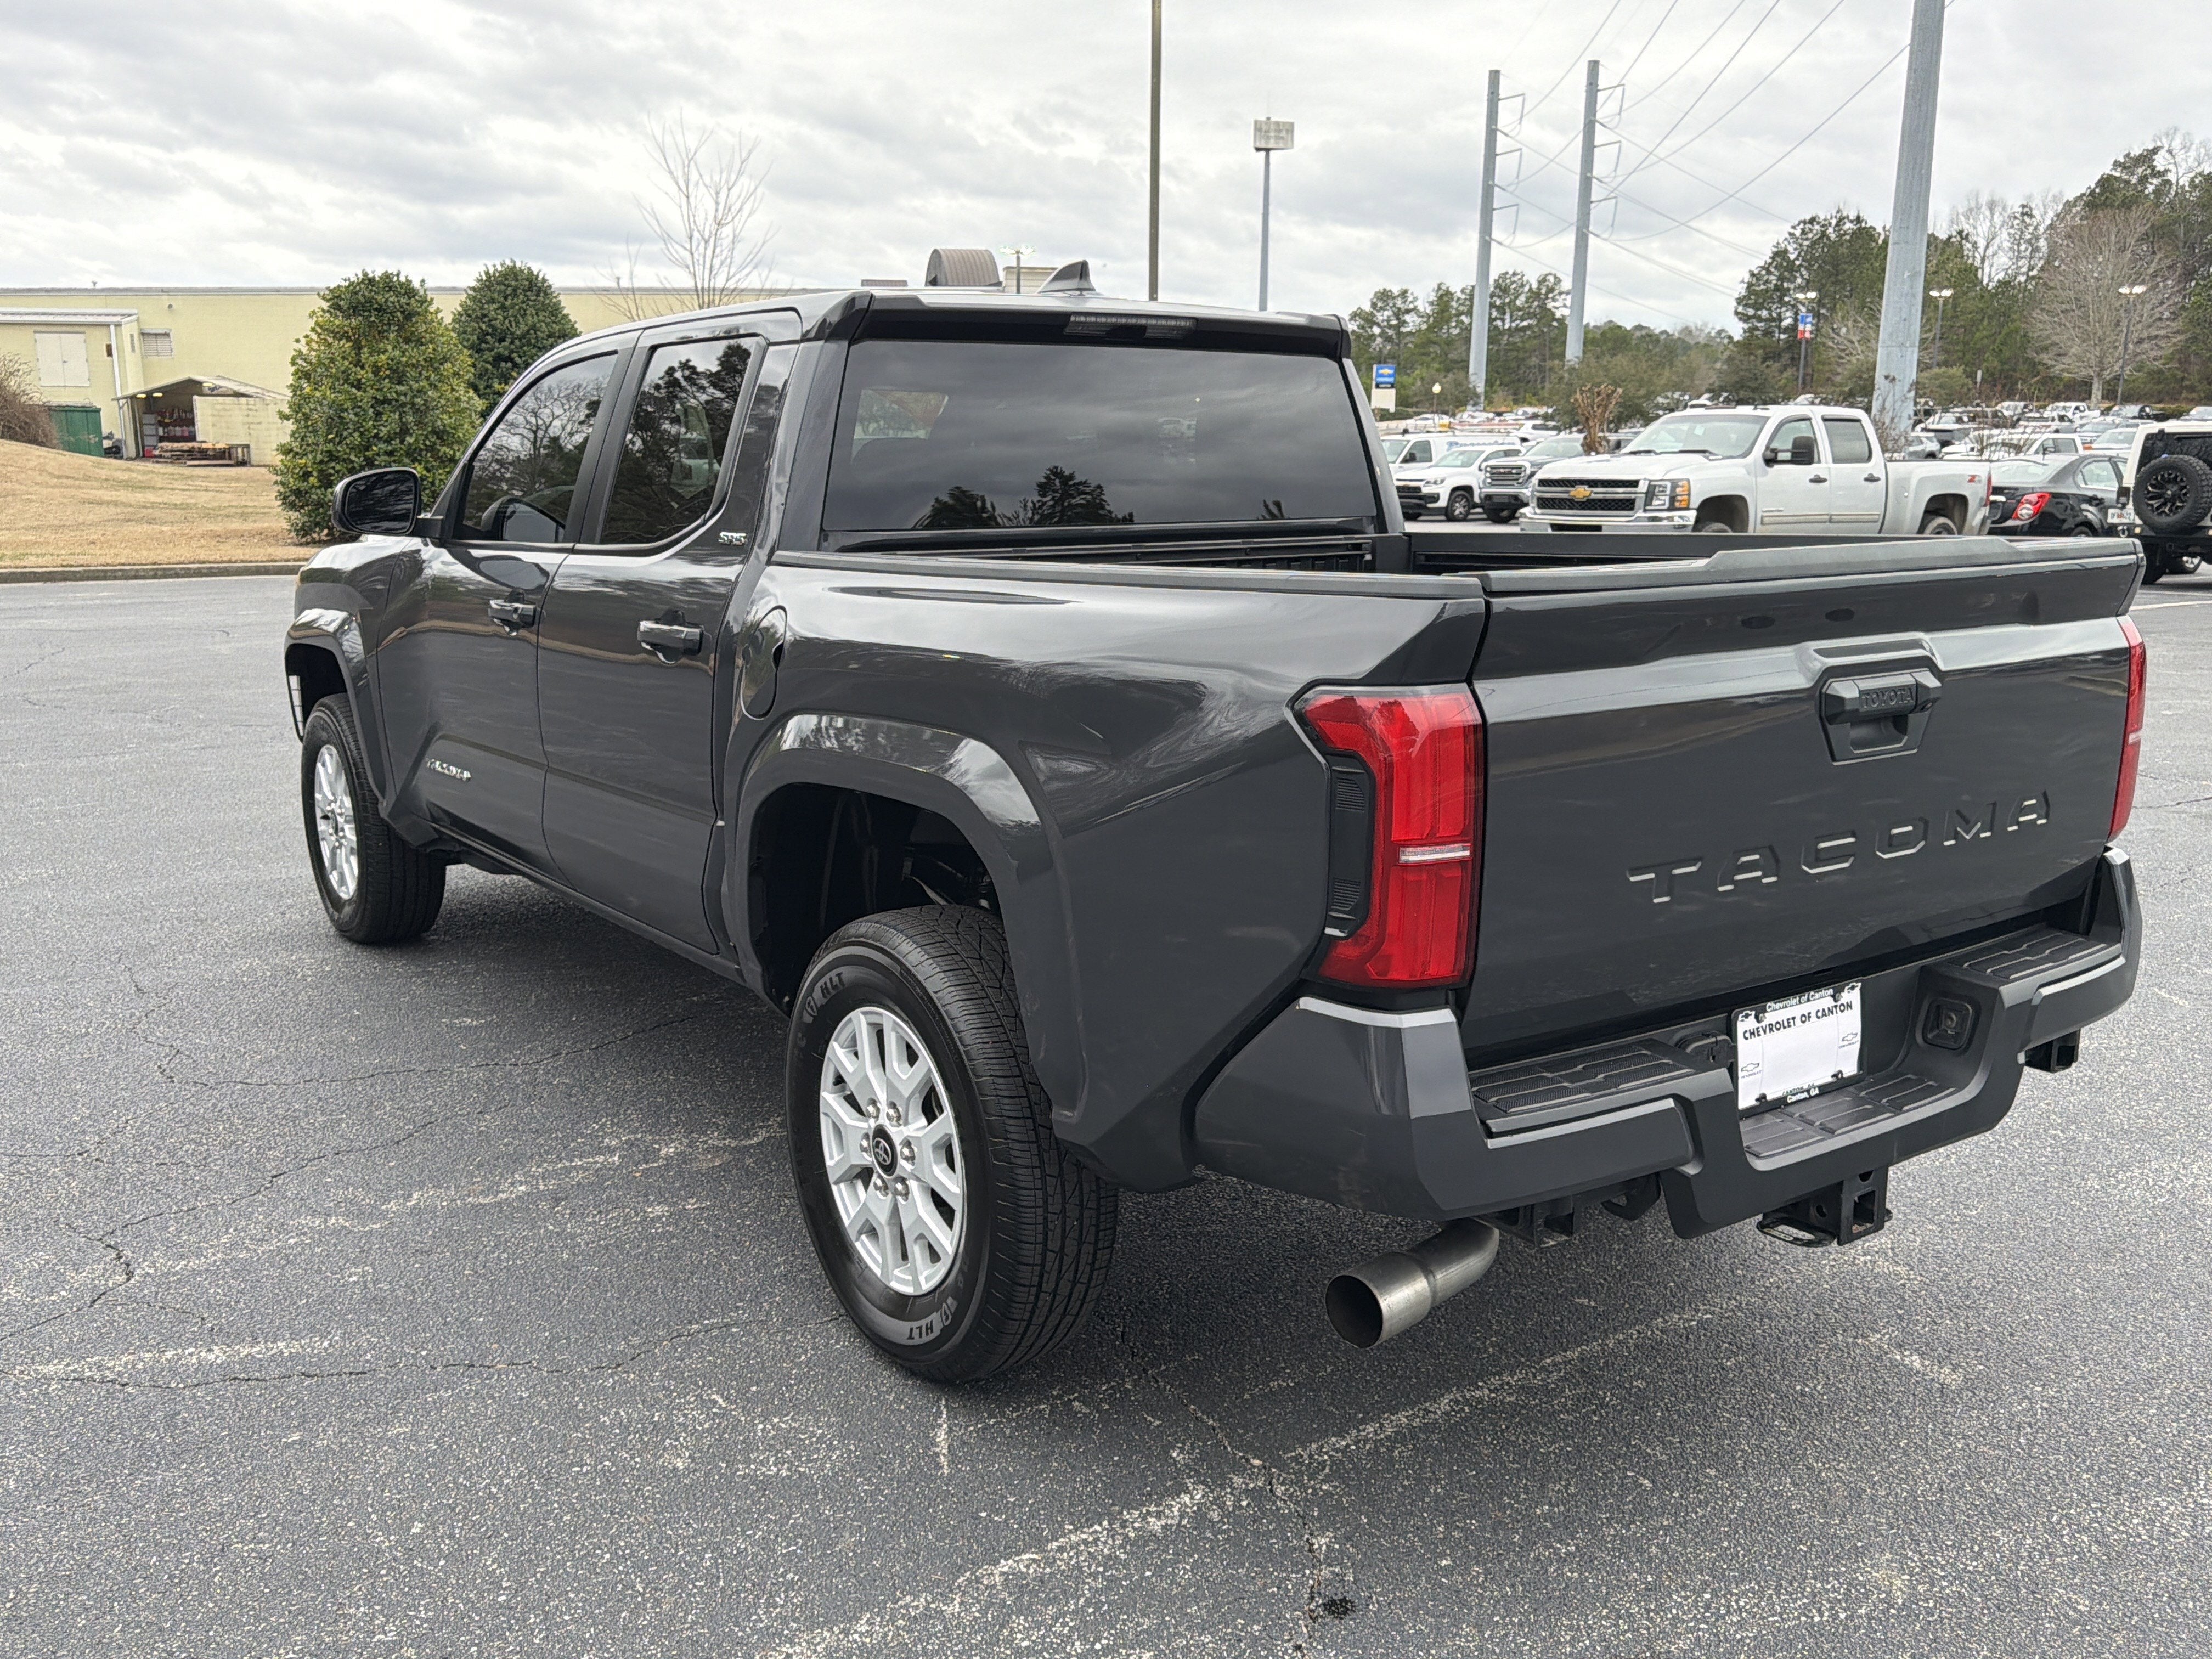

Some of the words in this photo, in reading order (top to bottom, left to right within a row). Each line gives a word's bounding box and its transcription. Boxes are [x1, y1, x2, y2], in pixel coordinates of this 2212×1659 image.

[1861, 687, 1914, 708] TOYOTA
[1626, 790, 2050, 903] TACOMA
[820, 972, 846, 999] HLT
[1765, 996, 1799, 1012] Chevrolet
[1801, 992, 1809, 1003] of
[1809, 988, 1833, 1001] Canton
[1743, 1016, 1796, 1040] CHEVROLET
[1800, 1012, 1812, 1024] OF
[1815, 1000, 1853, 1019] CANTON
[906, 1319, 934, 1340] HLT
